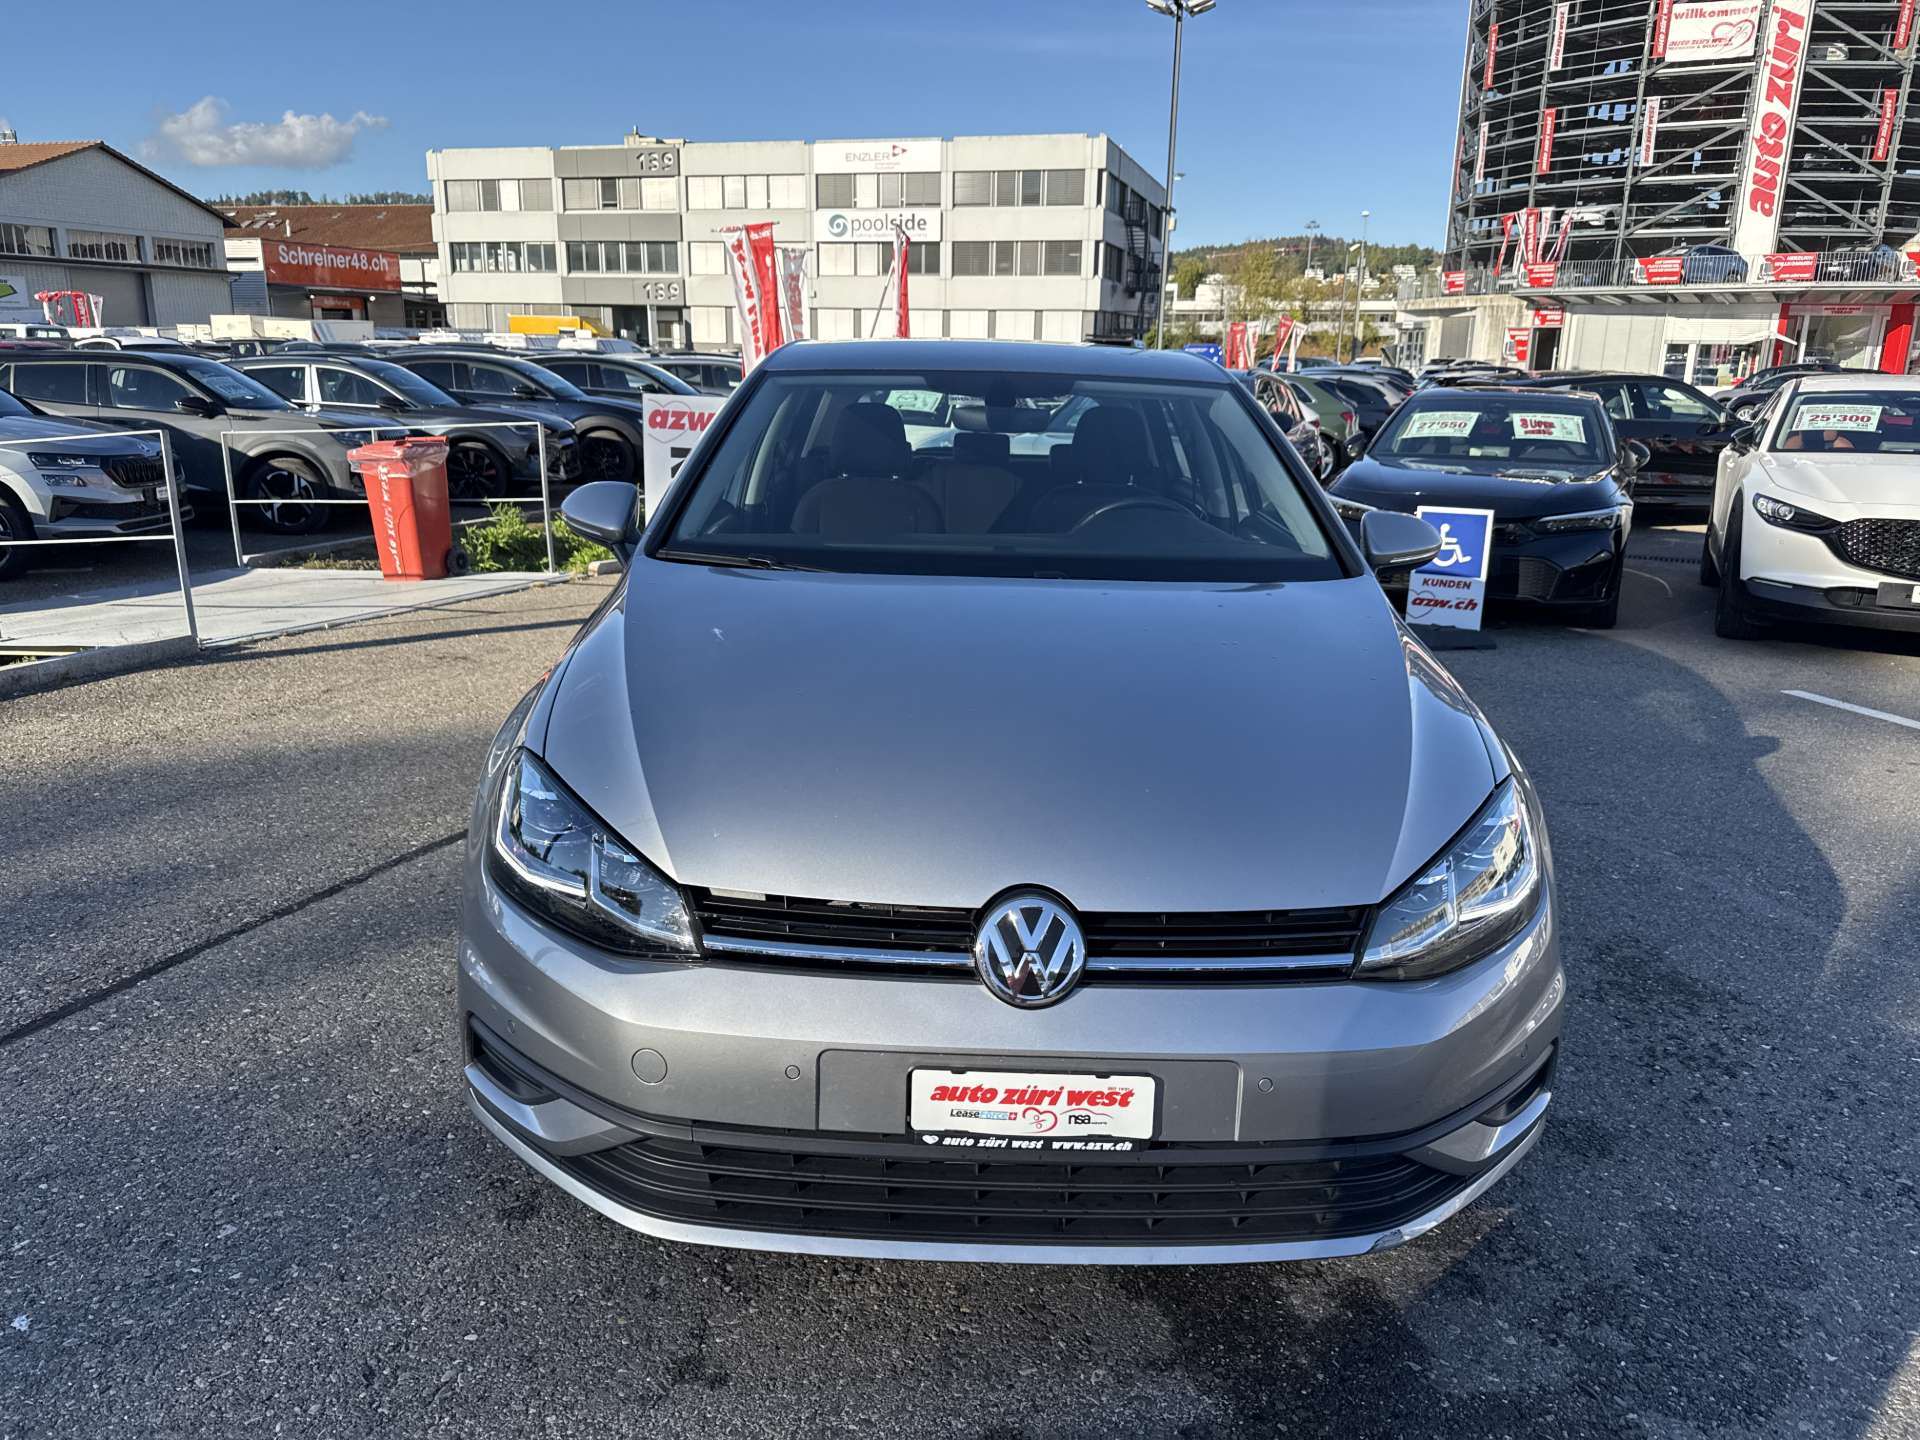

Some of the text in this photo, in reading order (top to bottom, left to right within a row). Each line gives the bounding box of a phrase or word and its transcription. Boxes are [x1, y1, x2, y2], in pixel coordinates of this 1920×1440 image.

[1750, 5, 1805, 217] auto züri
[636, 152, 673, 171] 139
[845, 152, 890, 161] ENZLER
[851, 213, 927, 237] poolside
[278, 245, 389, 272] Schreiner48.ch
[643, 282, 680, 300] 139
[1418, 421, 1467, 429] 27'550
[1808, 414, 1871, 422] 25'300
[1422, 578, 1472, 589] KUNDEN
[1411, 597, 1478, 611] azw.ch
[930, 1084, 1135, 1108] auto züri west
[1069, 1115, 1091, 1125] nsa
[942, 1137, 1133, 1151] auto züri west www.azw.ch
